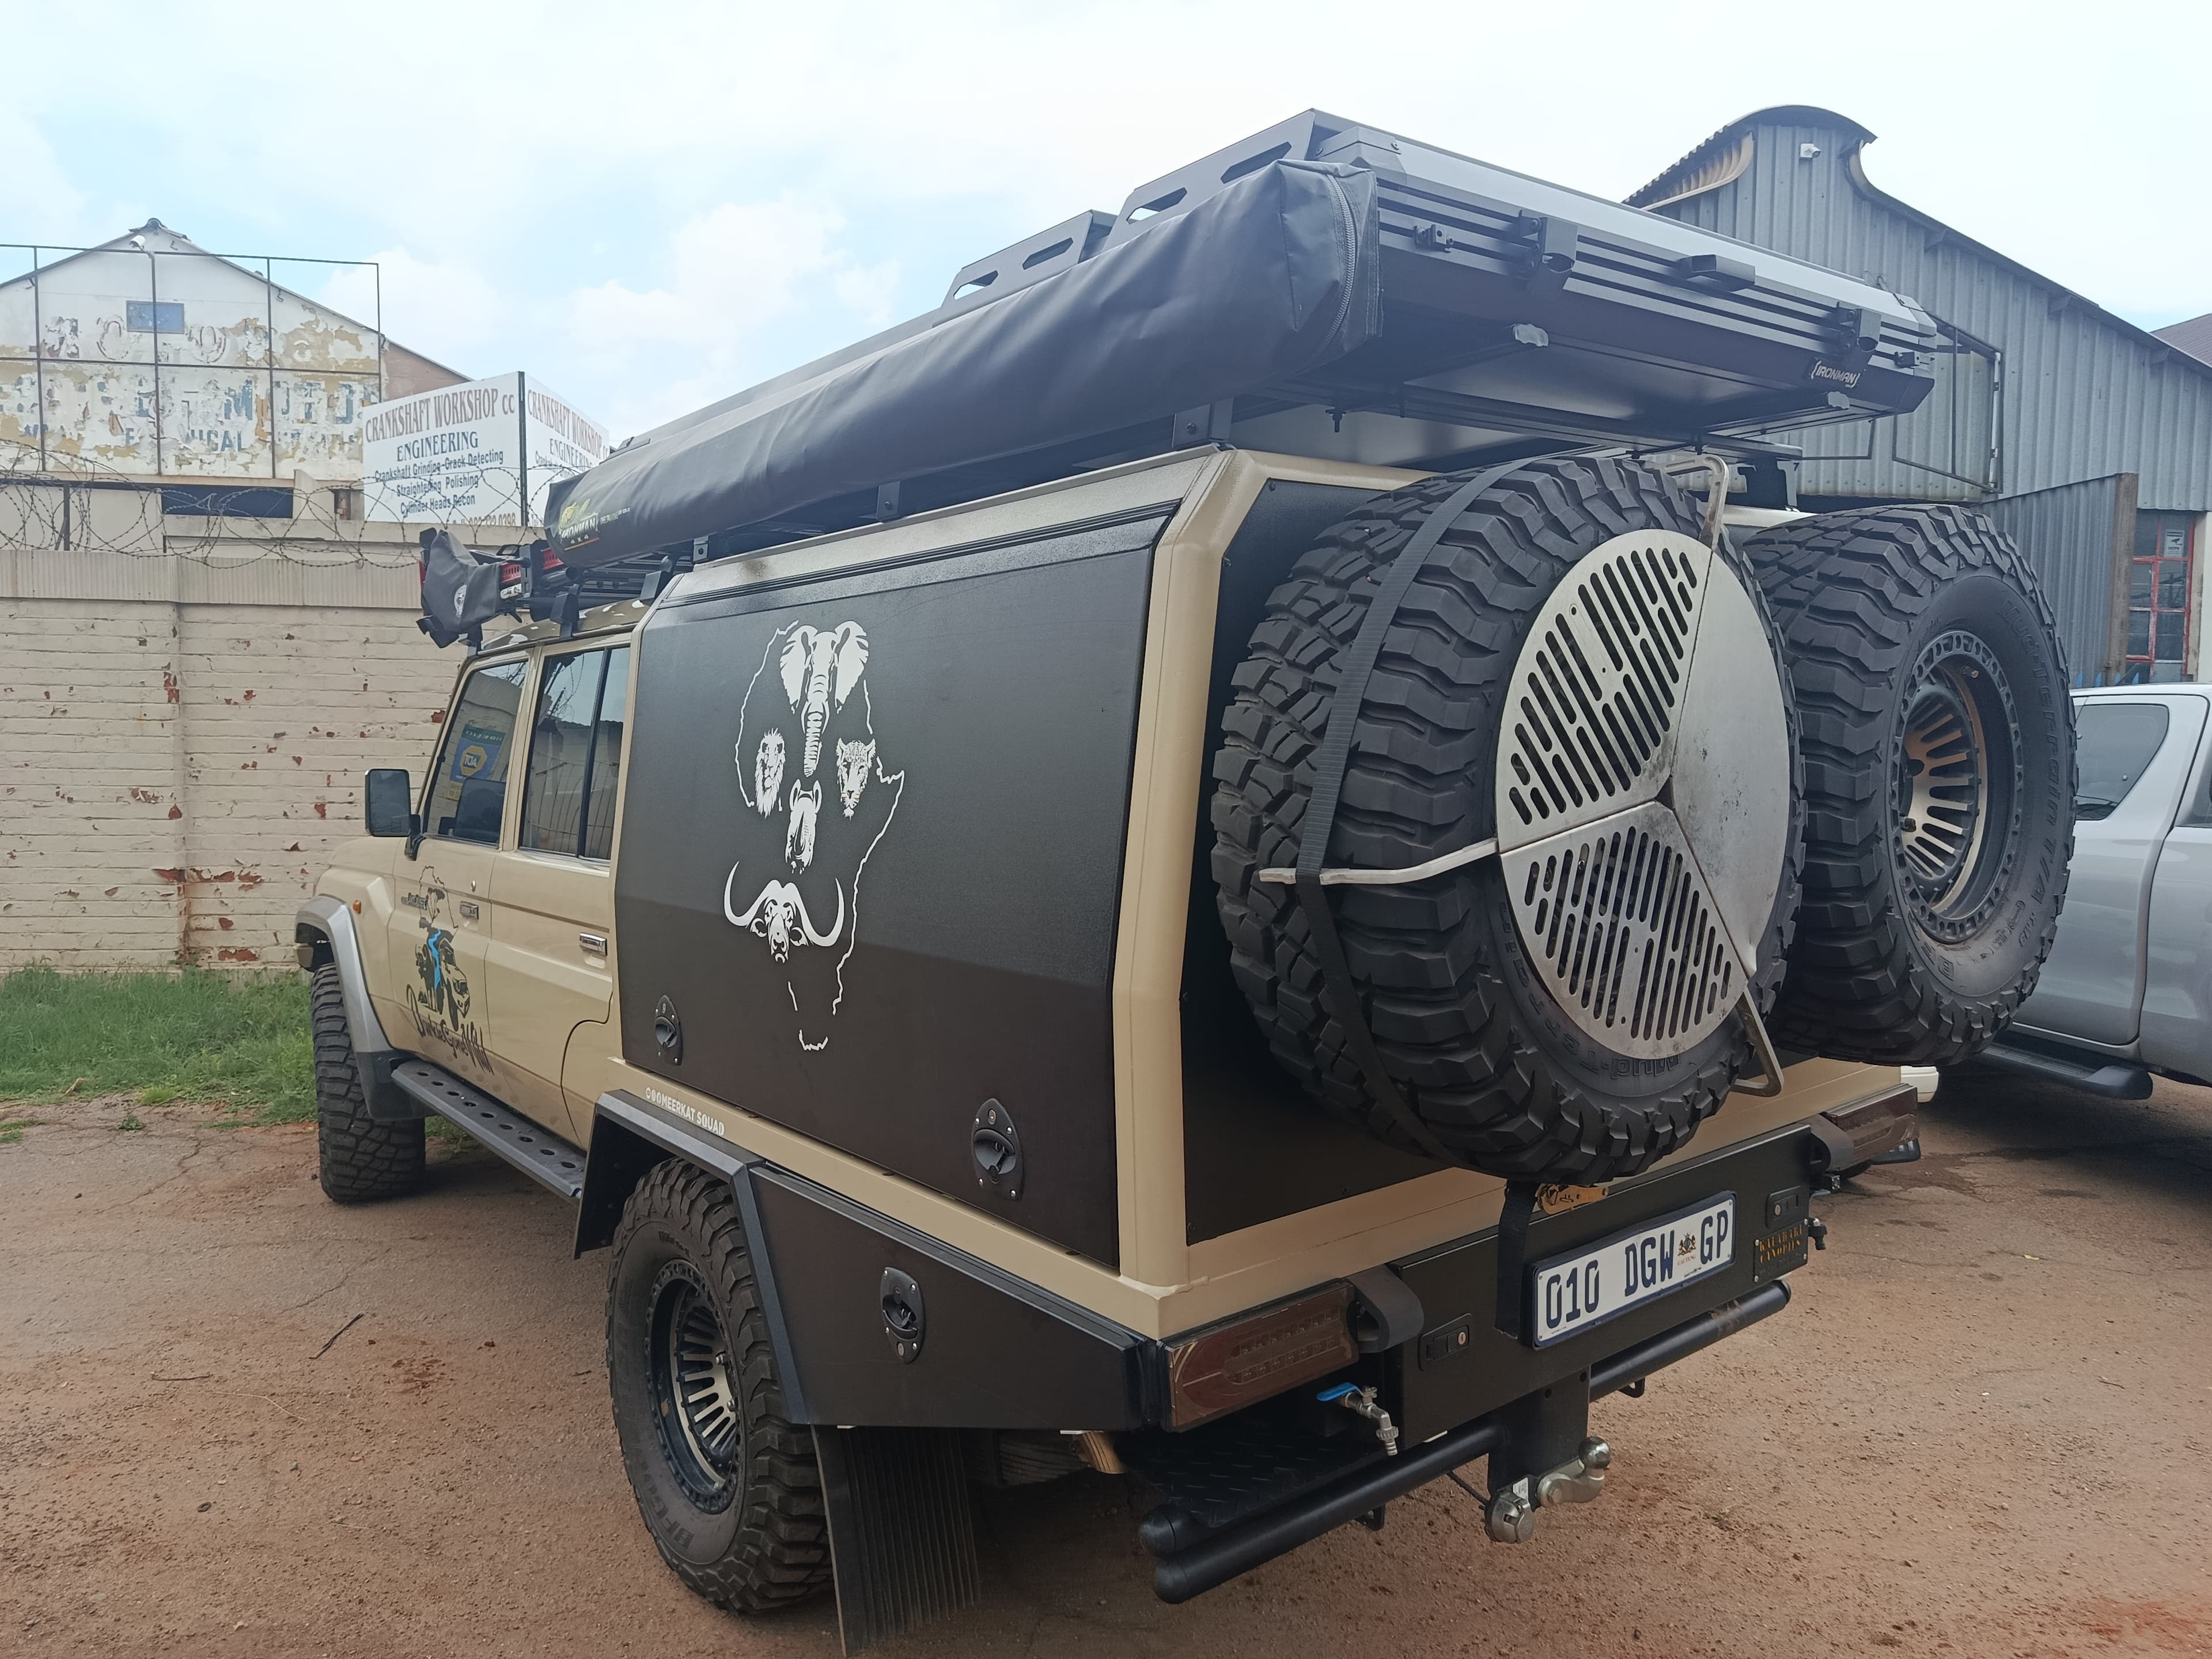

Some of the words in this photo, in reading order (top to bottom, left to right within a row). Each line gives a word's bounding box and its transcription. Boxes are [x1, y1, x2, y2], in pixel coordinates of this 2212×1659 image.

[1815, 365, 1857, 384] IRONMAN
[365, 397, 431, 443] CRANKSHAFT
[434, 388, 498, 428] WORKSHOP
[528, 389, 570, 440] CRANKSHAFT
[571, 411, 603, 459] WORKSHOP
[397, 431, 479, 461] ENGINEERING
[375, 463, 411, 482] Crankshaft
[413, 460, 441, 475] Grinding
[445, 457, 465, 470] Crack
[468, 449, 503, 465] Detecting
[446, 474, 479, 489] Polishing
[401, 501, 428, 516] Cylinder
[430, 498, 451, 510] Heads
[453, 494, 475, 506] Recon
[661, 1093, 696, 1121] MEERKAT
[696, 1111, 725, 1136] SQUAD
[1546, 1259, 1600, 1330] 010
[1624, 1229, 1675, 1297] DGW
[1700, 1209, 1729, 1265] GP
